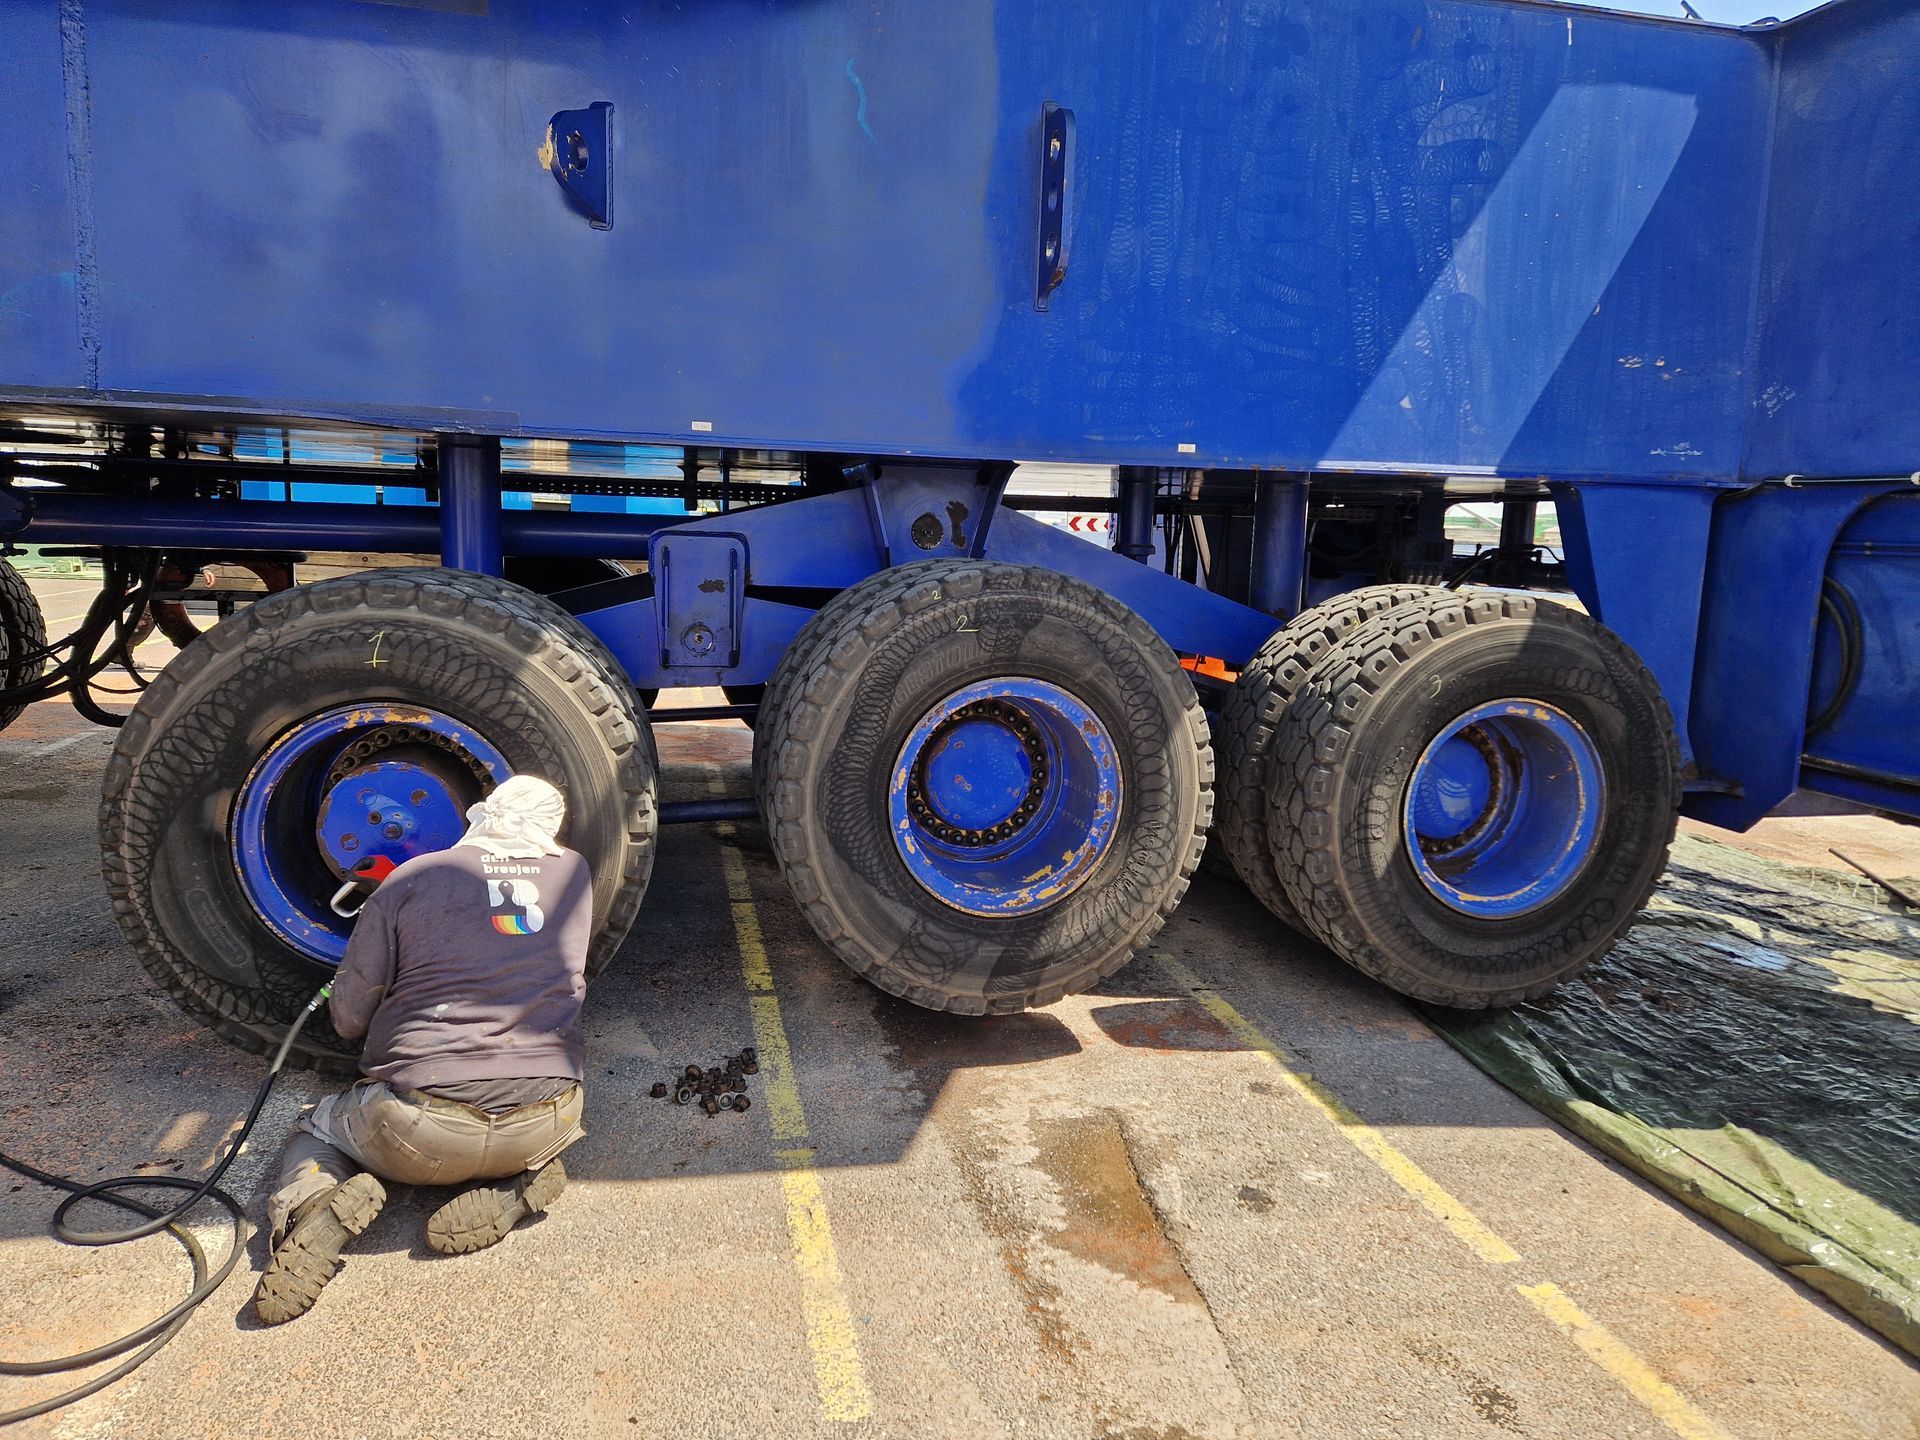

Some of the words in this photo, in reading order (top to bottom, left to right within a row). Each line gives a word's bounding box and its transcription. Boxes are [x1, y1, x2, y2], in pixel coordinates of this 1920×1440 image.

[931, 590, 942, 600] 2
[955, 614, 980, 633] 2
[363, 630, 390, 669] 1
[1428, 674, 1443, 699] 3
[482, 863, 541, 876] breejen
